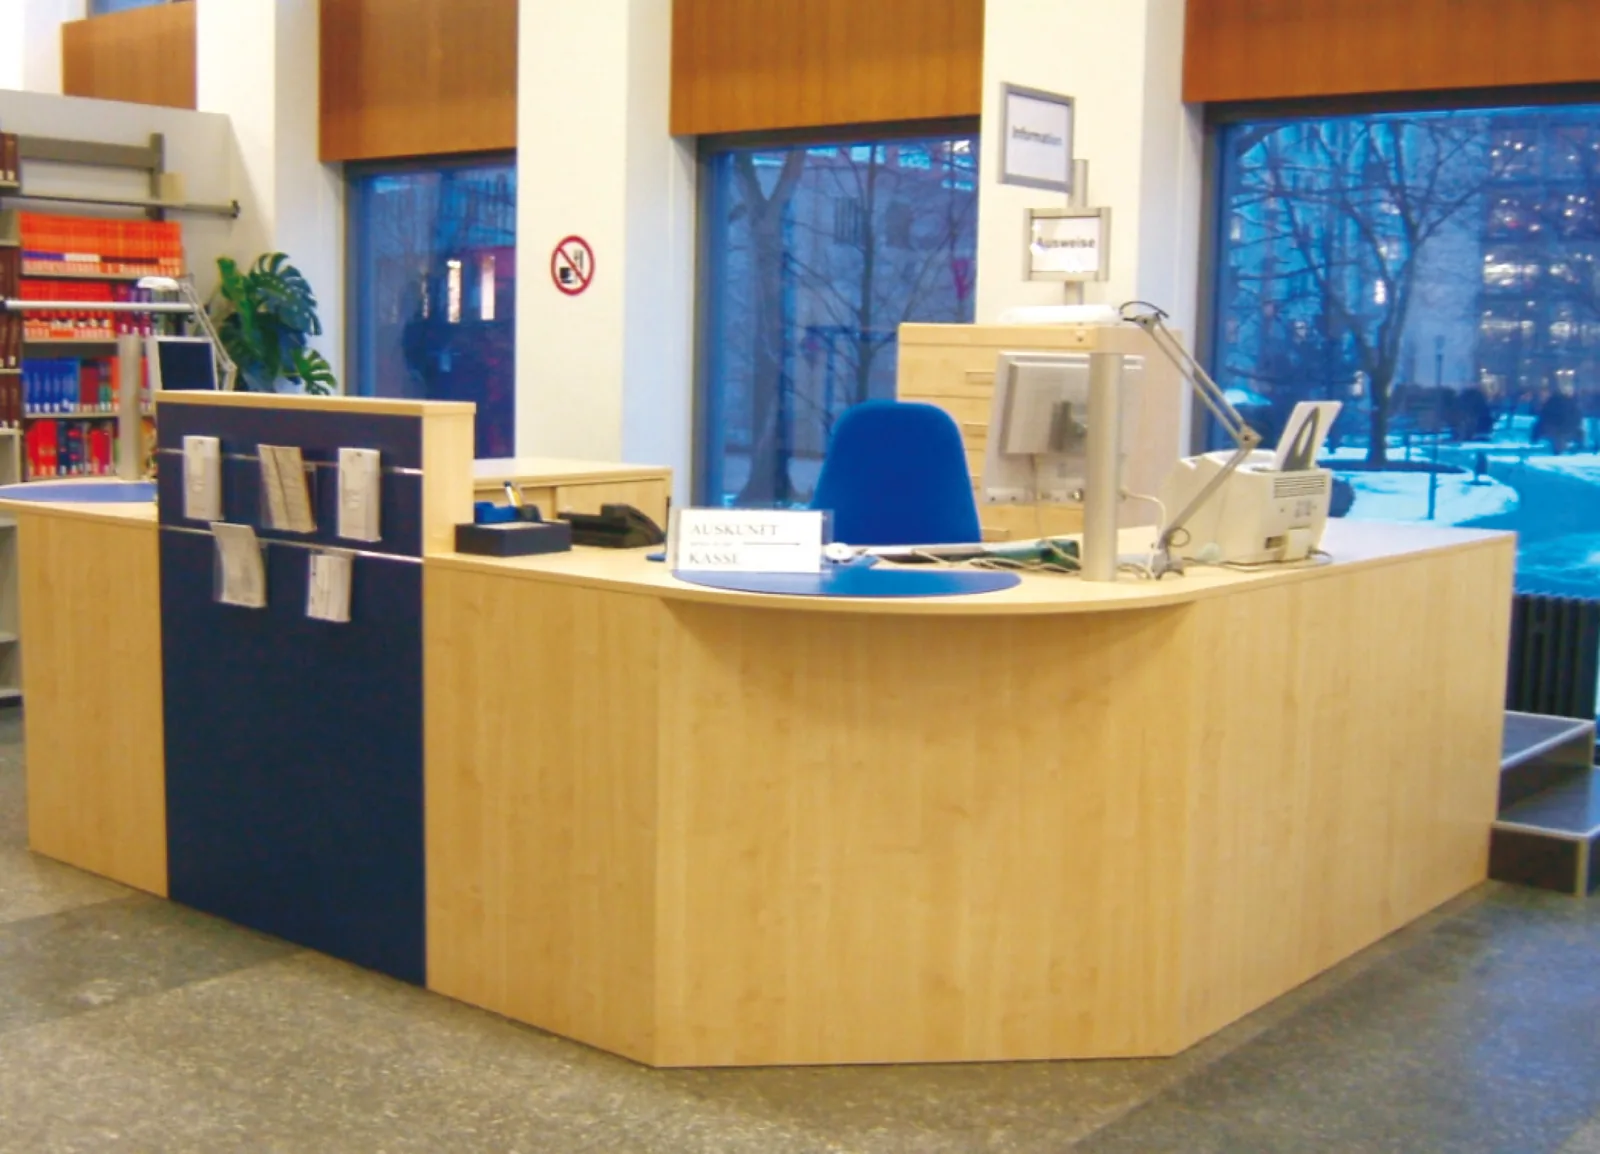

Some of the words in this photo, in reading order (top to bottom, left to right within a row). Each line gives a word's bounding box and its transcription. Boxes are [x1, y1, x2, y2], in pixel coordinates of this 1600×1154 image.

[1036, 236, 1095, 249] Ausweise
[690, 523, 780, 536] AUSKUNFT
[688, 552, 740, 565] KASSE
